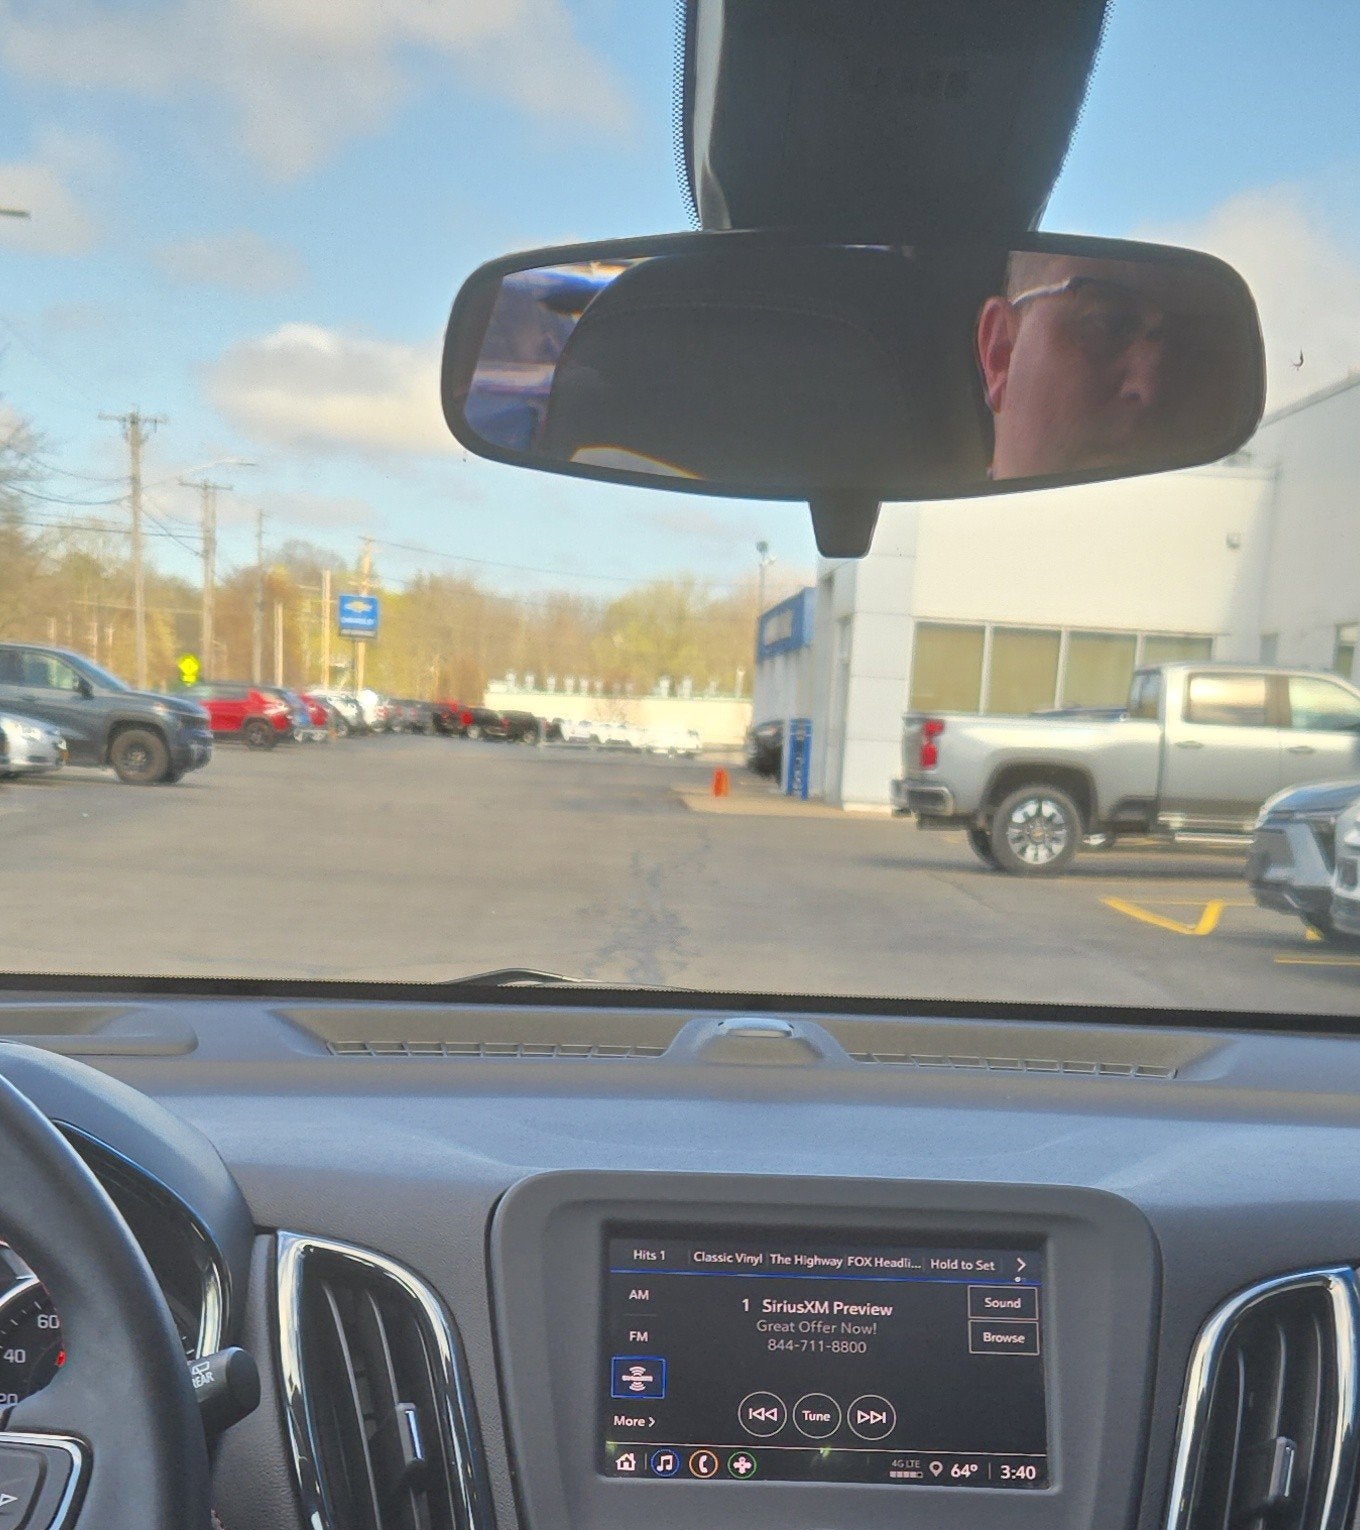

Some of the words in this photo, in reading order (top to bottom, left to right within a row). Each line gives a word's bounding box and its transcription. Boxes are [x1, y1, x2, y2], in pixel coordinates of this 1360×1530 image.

[633, 1250, 657, 1260] Hits
[660, 1250, 666, 1260] 1
[693, 1251, 733, 1263] Classic
[735, 1253, 763, 1266] Vinyl
[770, 1254, 792, 1265] The
[794, 1255, 843, 1269] Highway
[847, 1257, 872, 1267] FOX
[930, 1259, 957, 1270] Hold
[960, 1260, 973, 1270] to
[975, 1260, 995, 1271] Set
[628, 1289, 650, 1301] AM
[742, 1298, 750, 1312] 1
[762, 1299, 830, 1315] SiriusXM
[833, 1301, 893, 1316] Preview
[984, 1297, 1022, 1309] Sound
[37, 1314, 60, 1329] 60
[756, 1320, 795, 1333] Great
[798, 1320, 837, 1334] Offer
[840, 1322, 878, 1335] Now!
[629, 1331, 649, 1342] FM
[982, 1332, 1026, 1344] Browse
[767, 1338, 868, 1354] 844-711-8800
[3, 1349, 26, 1363] 40
[613, 1416, 646, 1427] More
[801, 1410, 831, 1422] Tune
[892, 1460, 904, 1468] 4G
[906, 1460, 920, 1468] LTE
[1000, 1465, 1037, 1480] 3:40
